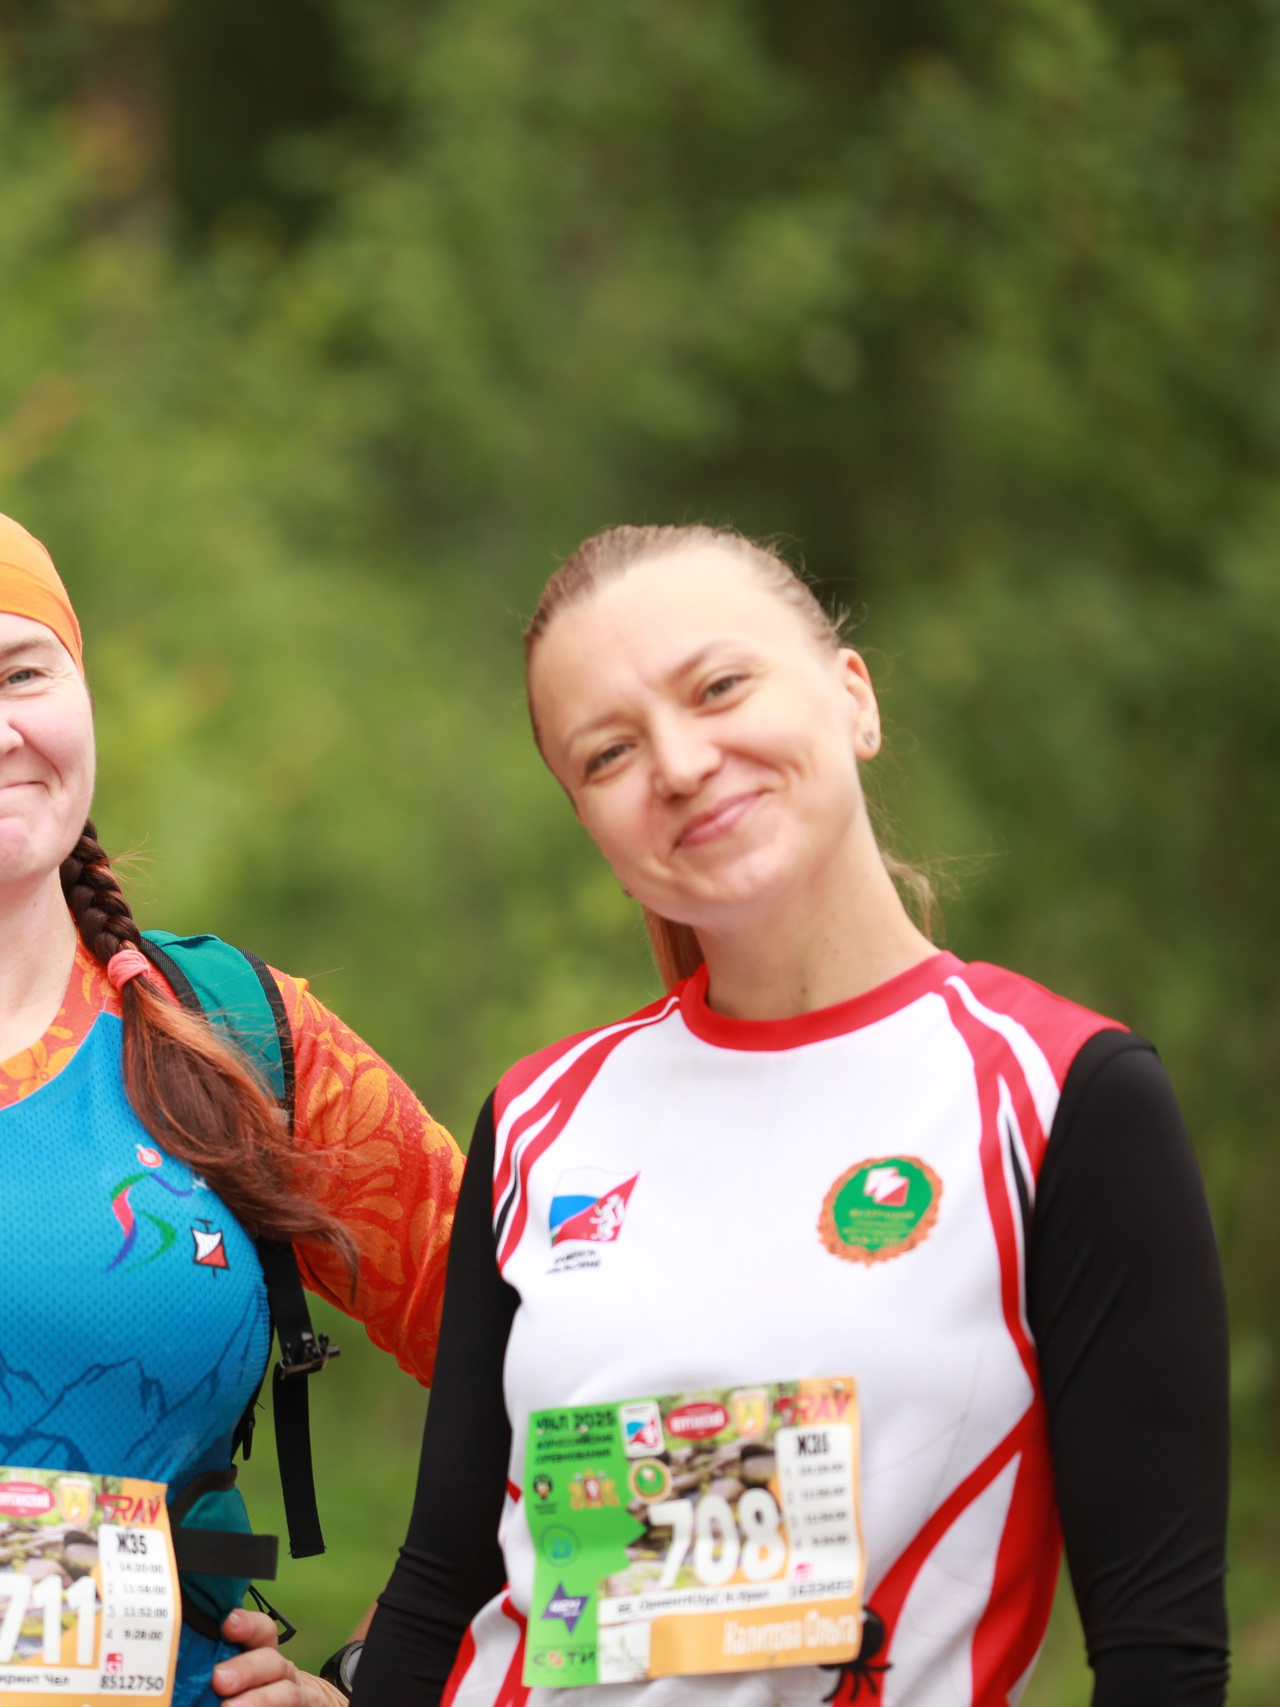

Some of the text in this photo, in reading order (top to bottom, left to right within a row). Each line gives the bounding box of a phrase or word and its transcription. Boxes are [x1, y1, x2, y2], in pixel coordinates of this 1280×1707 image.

[573, 1410, 616, 1430] 2025
[116, 1533, 147, 1554] Ж35
[647, 1487, 787, 1589] 708
[44, 1672, 70, 1686] Чел
[99, 1674, 165, 1691] 8512750
